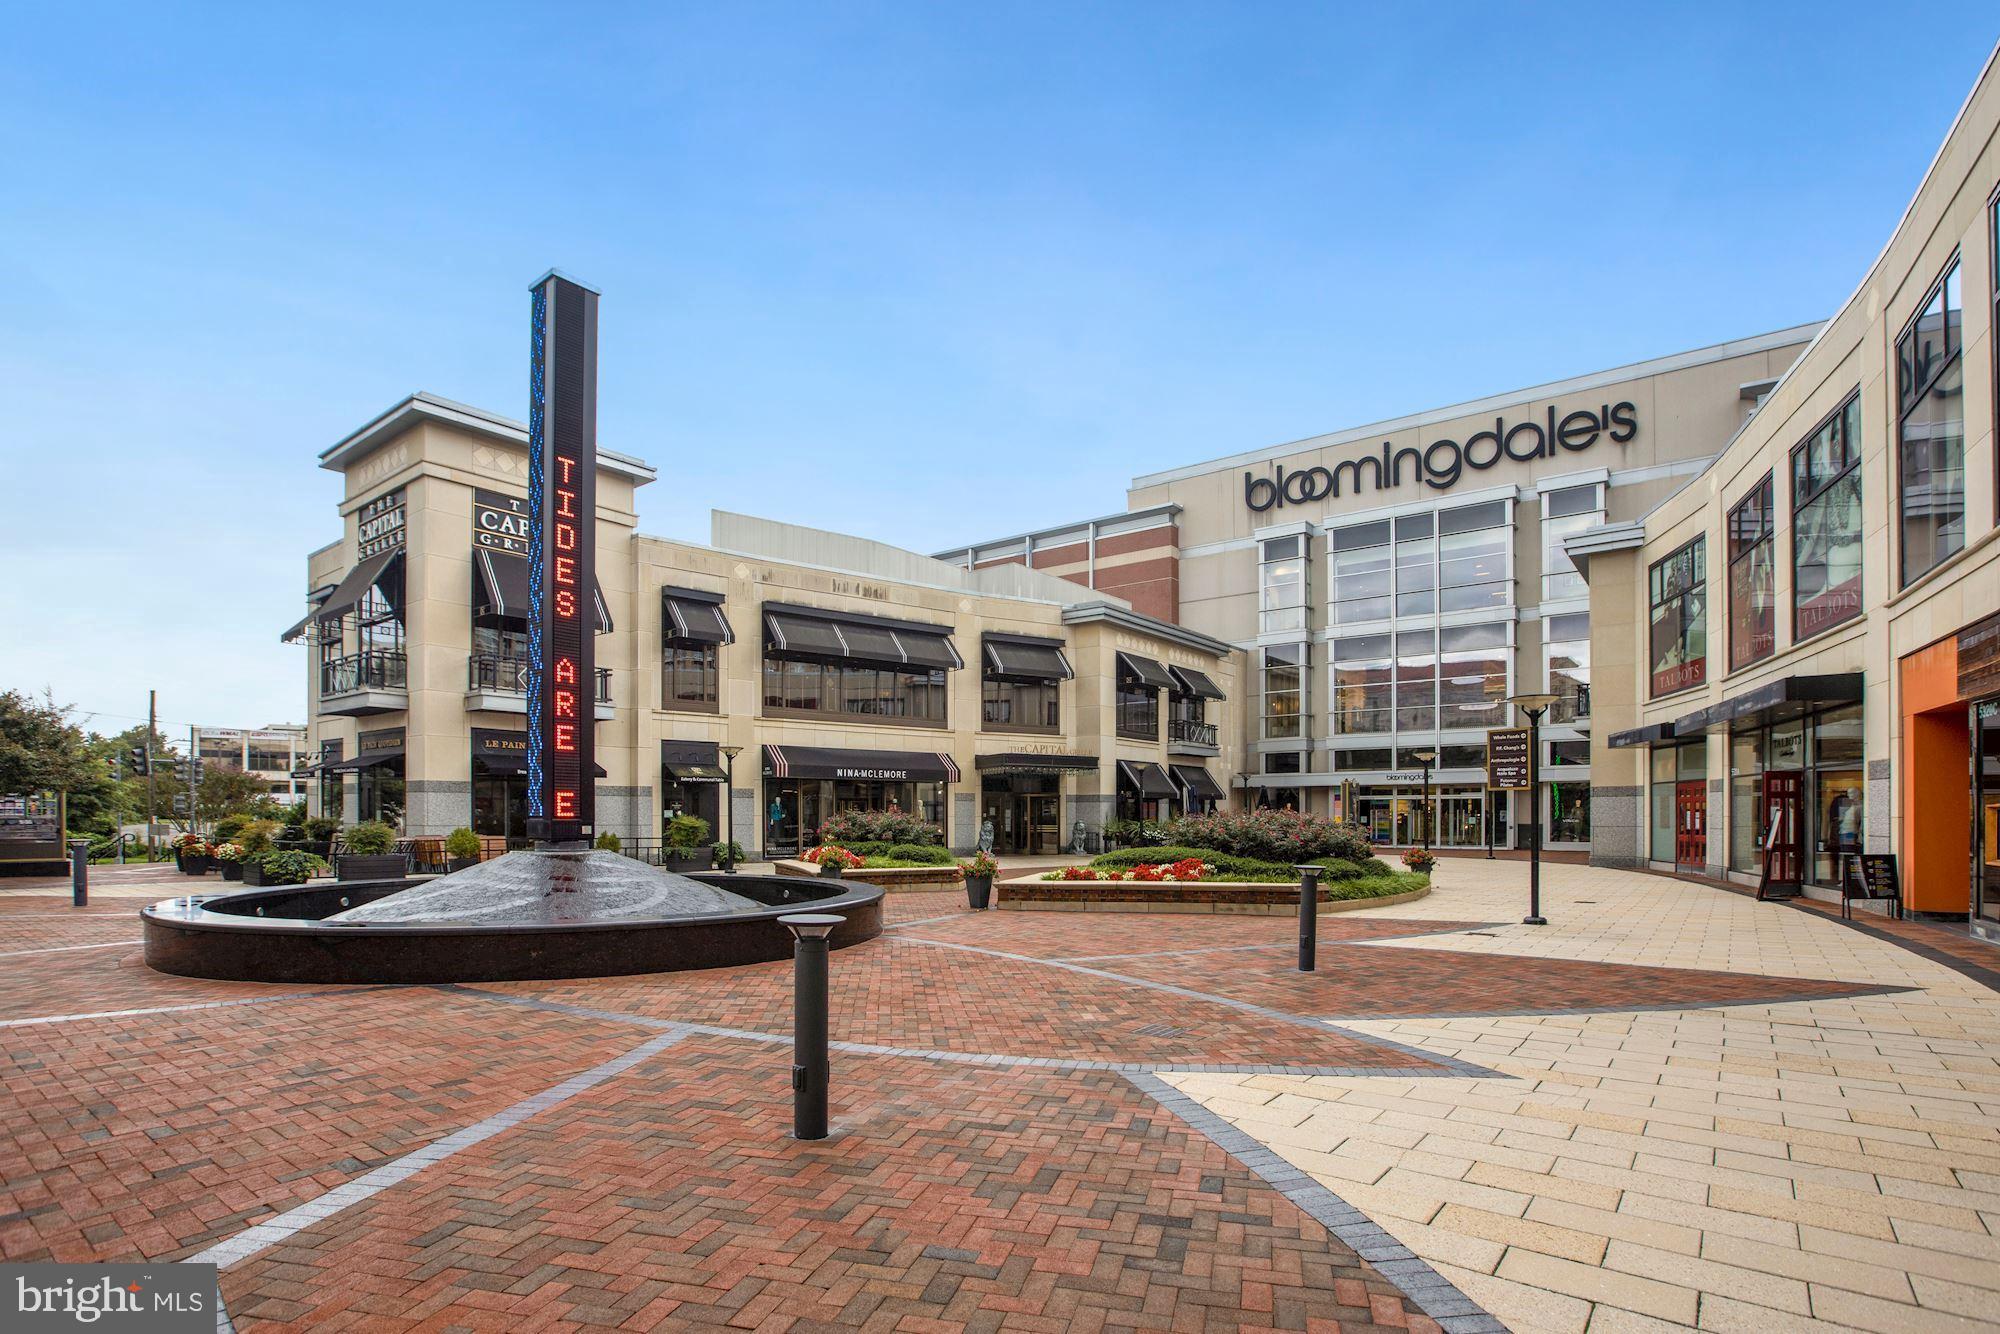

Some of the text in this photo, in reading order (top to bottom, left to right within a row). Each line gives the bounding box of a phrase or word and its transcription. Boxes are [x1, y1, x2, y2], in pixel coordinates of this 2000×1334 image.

[1245, 401, 1638, 512] bloomingdale's
[359, 509, 405, 544] CAPITAL
[556, 456, 575, 617] TIDES
[485, 740, 526, 749] LE PAIN
[556, 658, 574, 750] ARE
